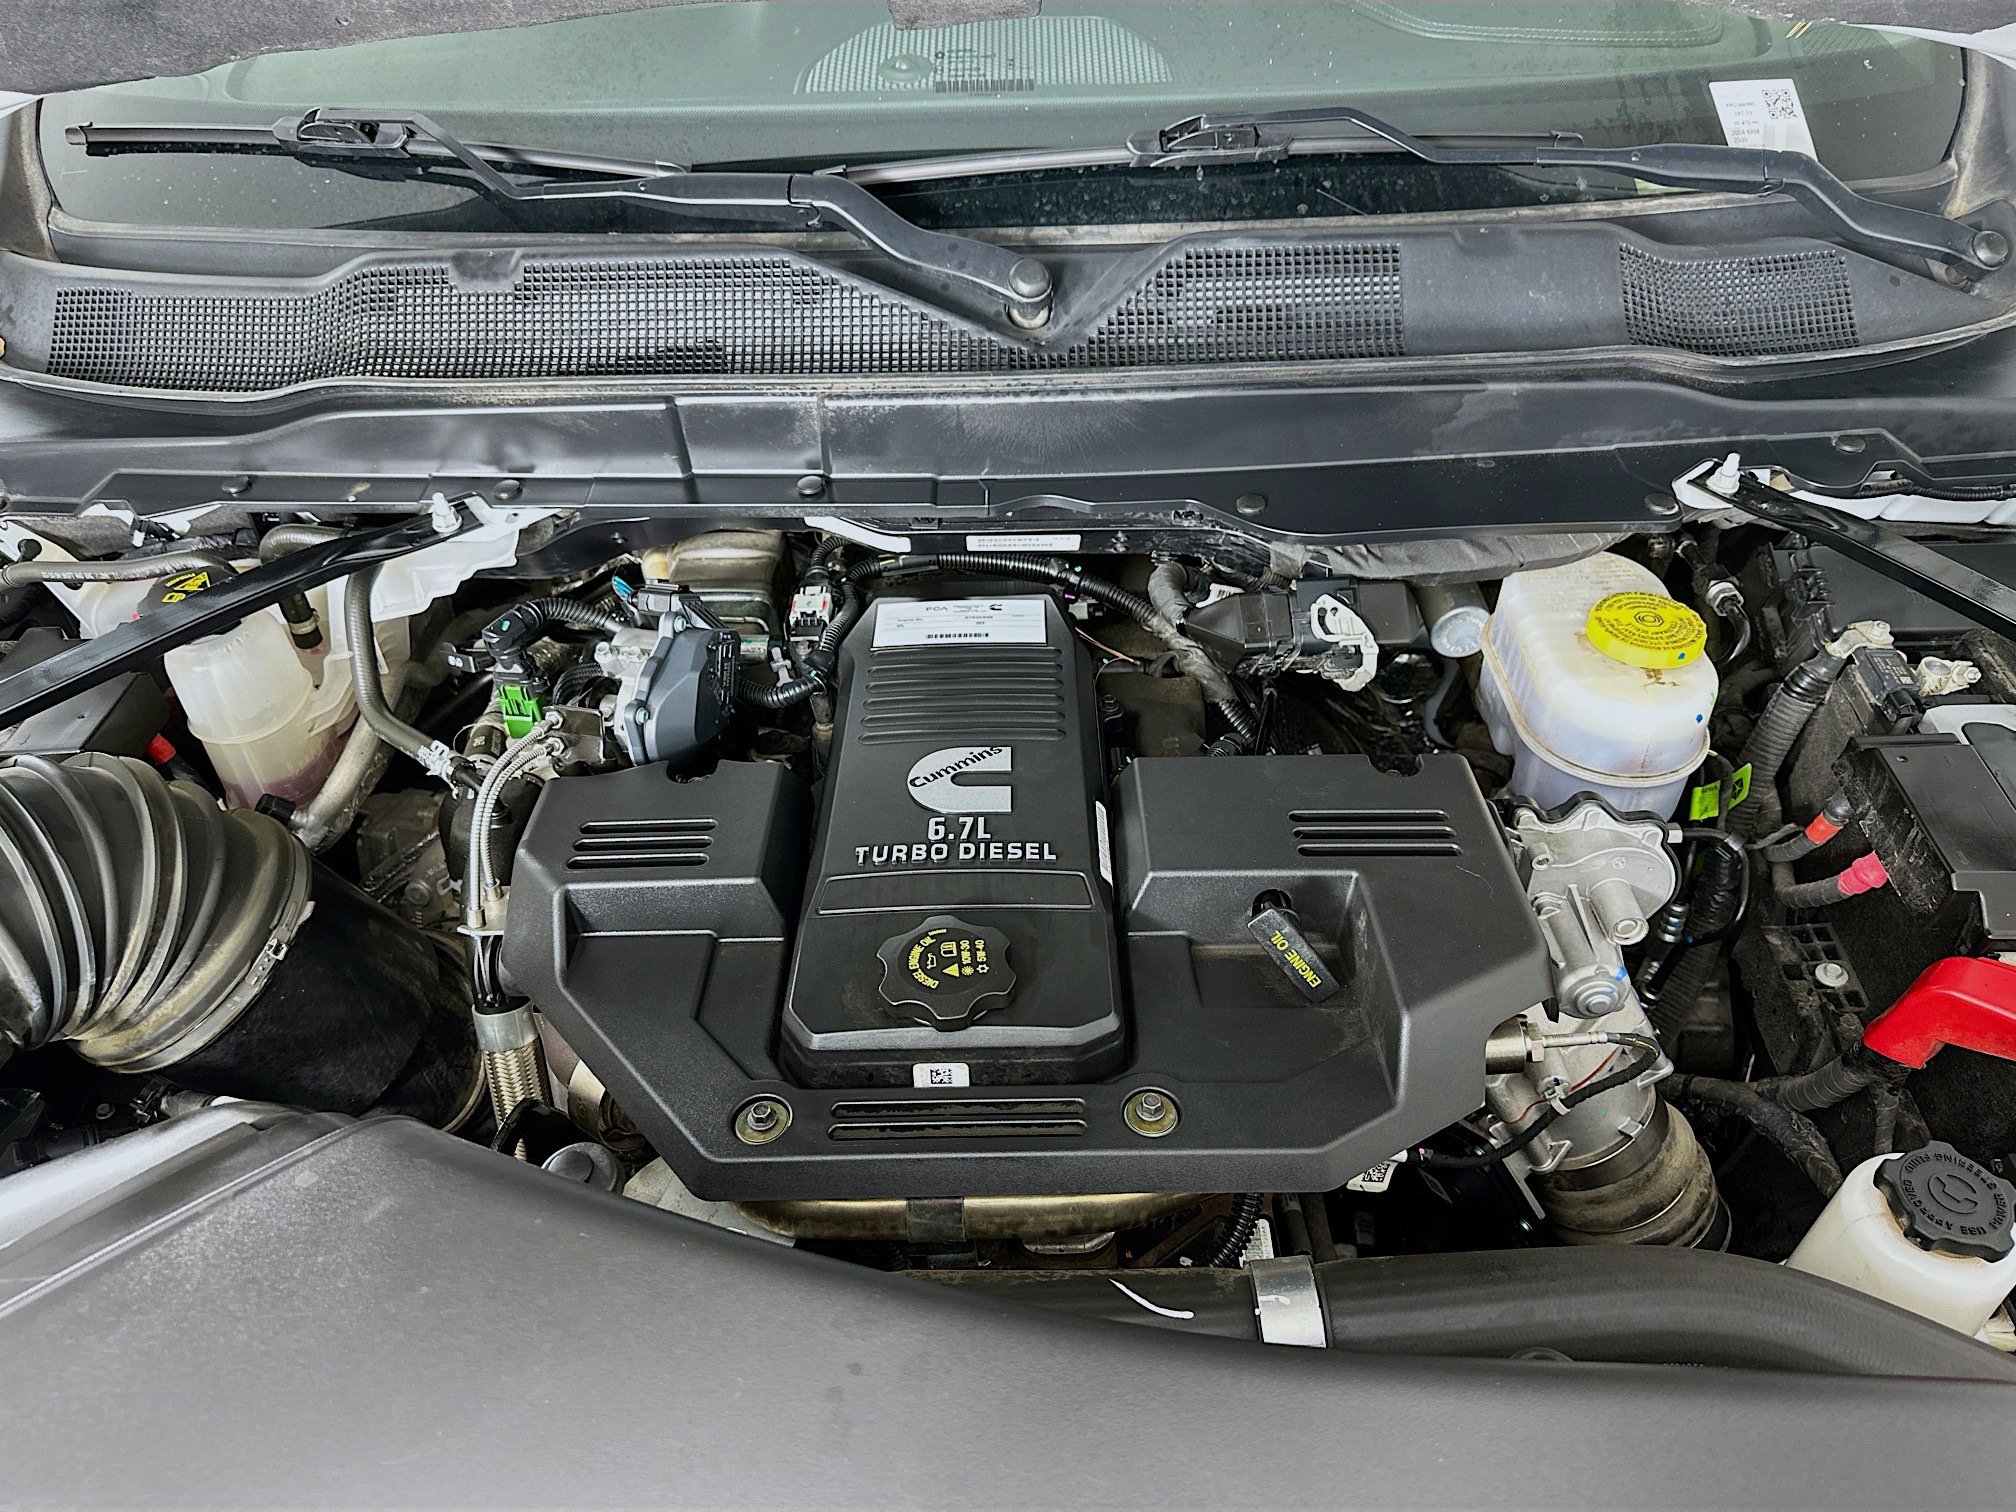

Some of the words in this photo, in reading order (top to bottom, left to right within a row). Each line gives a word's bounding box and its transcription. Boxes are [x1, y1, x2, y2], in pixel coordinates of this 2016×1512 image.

[909, 746, 1003, 788] Cummins
[927, 816, 991, 842] 6.7L
[855, 843, 948, 865] TURBO
[959, 842, 1057, 862] DIESEL
[920, 936, 936, 947] OIL
[960, 940, 971, 964] 10W-30
[975, 940, 987, 962] 5W-40
[1270, 930, 1290, 951] OIL
[908, 944, 925, 970] ENGINE
[1284, 949, 1322, 988] ENGINE
[912, 968, 939, 989] DIESEL
[1934, 1152, 1998, 1190] STEERING
[1903, 1179, 1954, 1231] APPROVED
